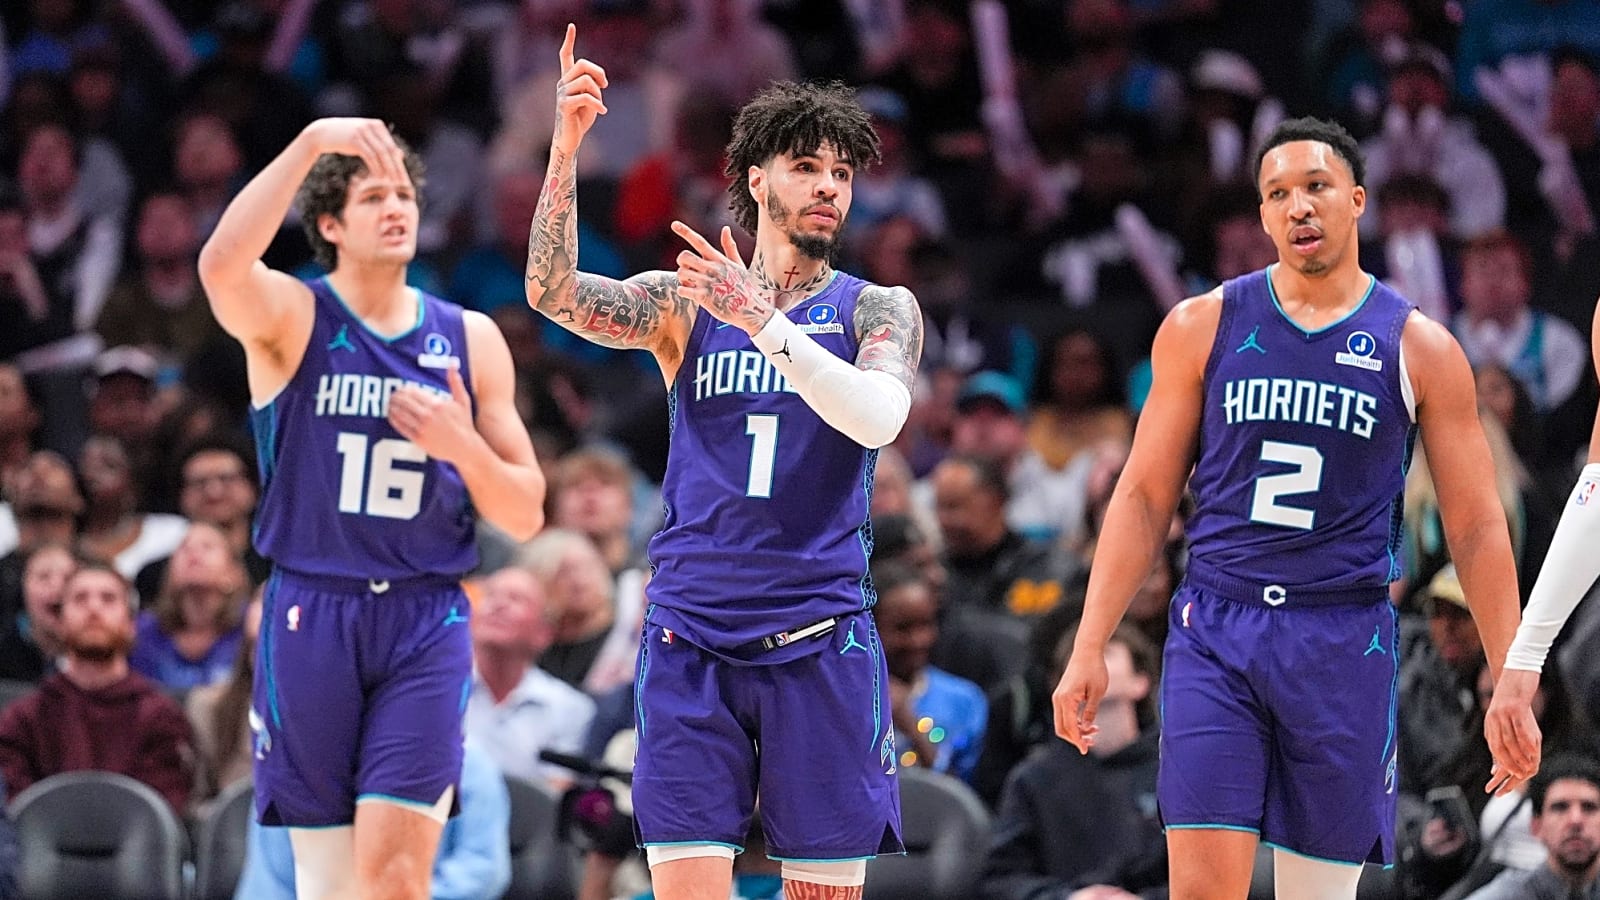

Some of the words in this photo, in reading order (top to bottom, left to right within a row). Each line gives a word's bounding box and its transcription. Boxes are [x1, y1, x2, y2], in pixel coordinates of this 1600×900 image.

[818, 324, 842, 333] Health
[315, 374, 453, 418] HORN
[692, 350, 798, 402] HORN
[1222, 378, 1379, 440] HORNETS
[337, 432, 427, 521] 16
[745, 413, 779, 498] 1
[1250, 440, 1323, 531] 2
